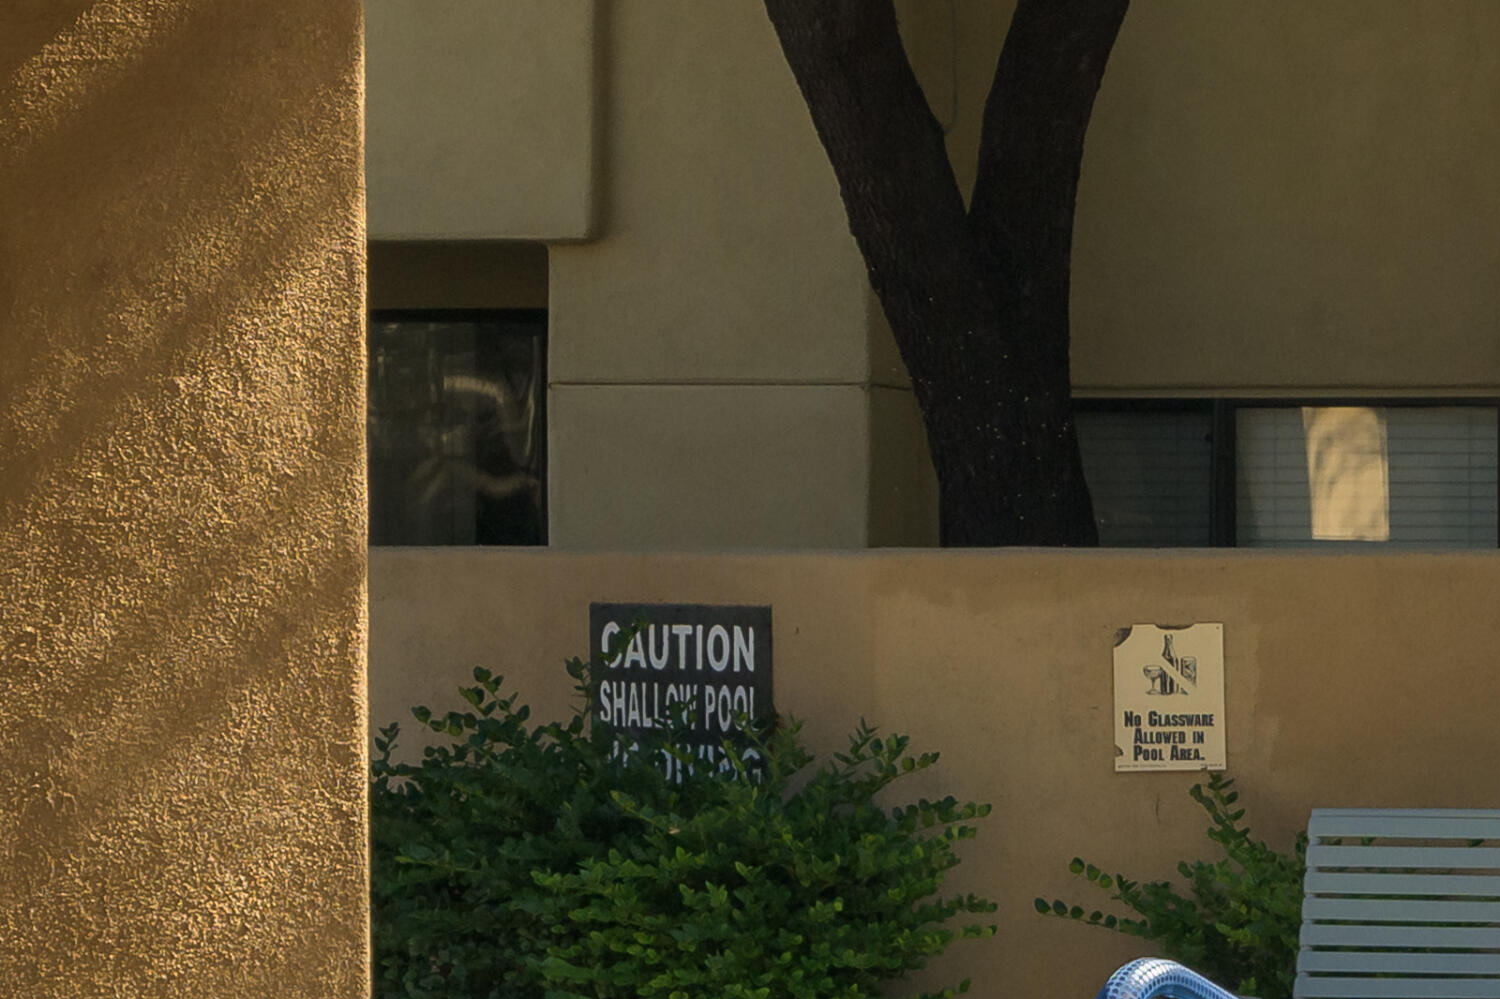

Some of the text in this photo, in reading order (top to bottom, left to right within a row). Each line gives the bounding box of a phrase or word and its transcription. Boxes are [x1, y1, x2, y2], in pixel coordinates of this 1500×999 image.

[601, 621, 755, 672] CAUTION
[704, 684, 759, 732] POOL
[1133, 745, 1165, 761] POOL
